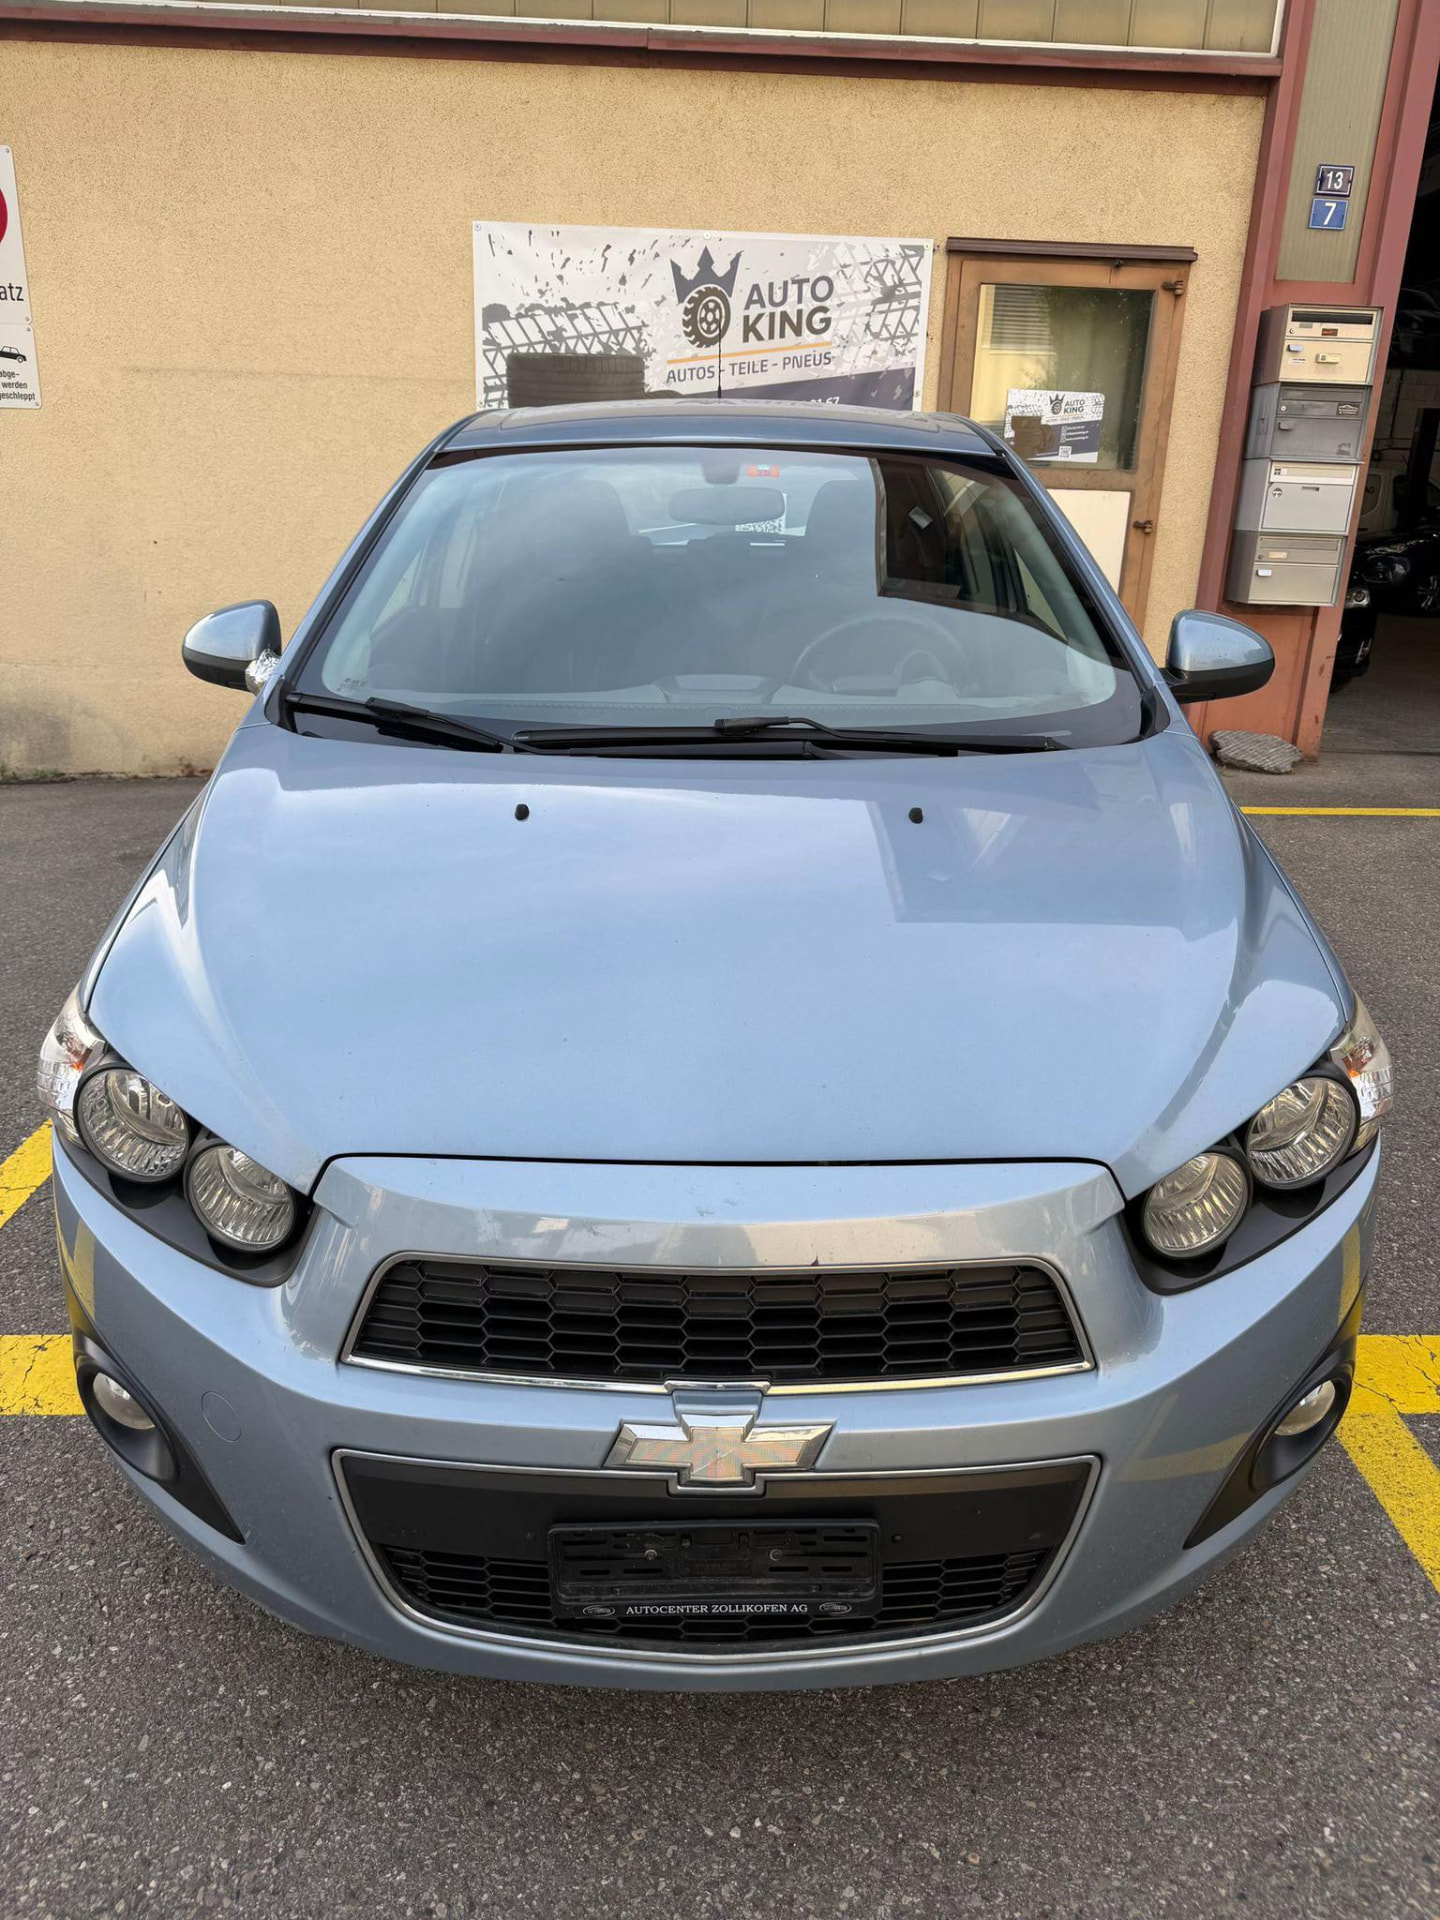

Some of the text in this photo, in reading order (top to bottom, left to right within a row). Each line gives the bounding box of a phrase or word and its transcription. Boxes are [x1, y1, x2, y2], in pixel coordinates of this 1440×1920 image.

[1326, 170, 1344, 190] 13
[1323, 202, 1337, 226] 7
[0, 282, 24, 301] atz
[743, 275, 834, 311] AUTO
[742, 305, 832, 344] KING
[666, 364, 716, 384] AUTOS
[729, 359, 769, 377] TEILE
[782, 351, 832, 370] PNEUS
[1, 381, 28, 389] werden
[1064, 406, 1084, 414] KING
[1065, 399, 1085, 407] AUTO
[626, 1605, 708, 1615] AUTOCENTER
[711, 1603, 788, 1614] ZOLLIKOFEN
[790, 1603, 808, 1613] AG
